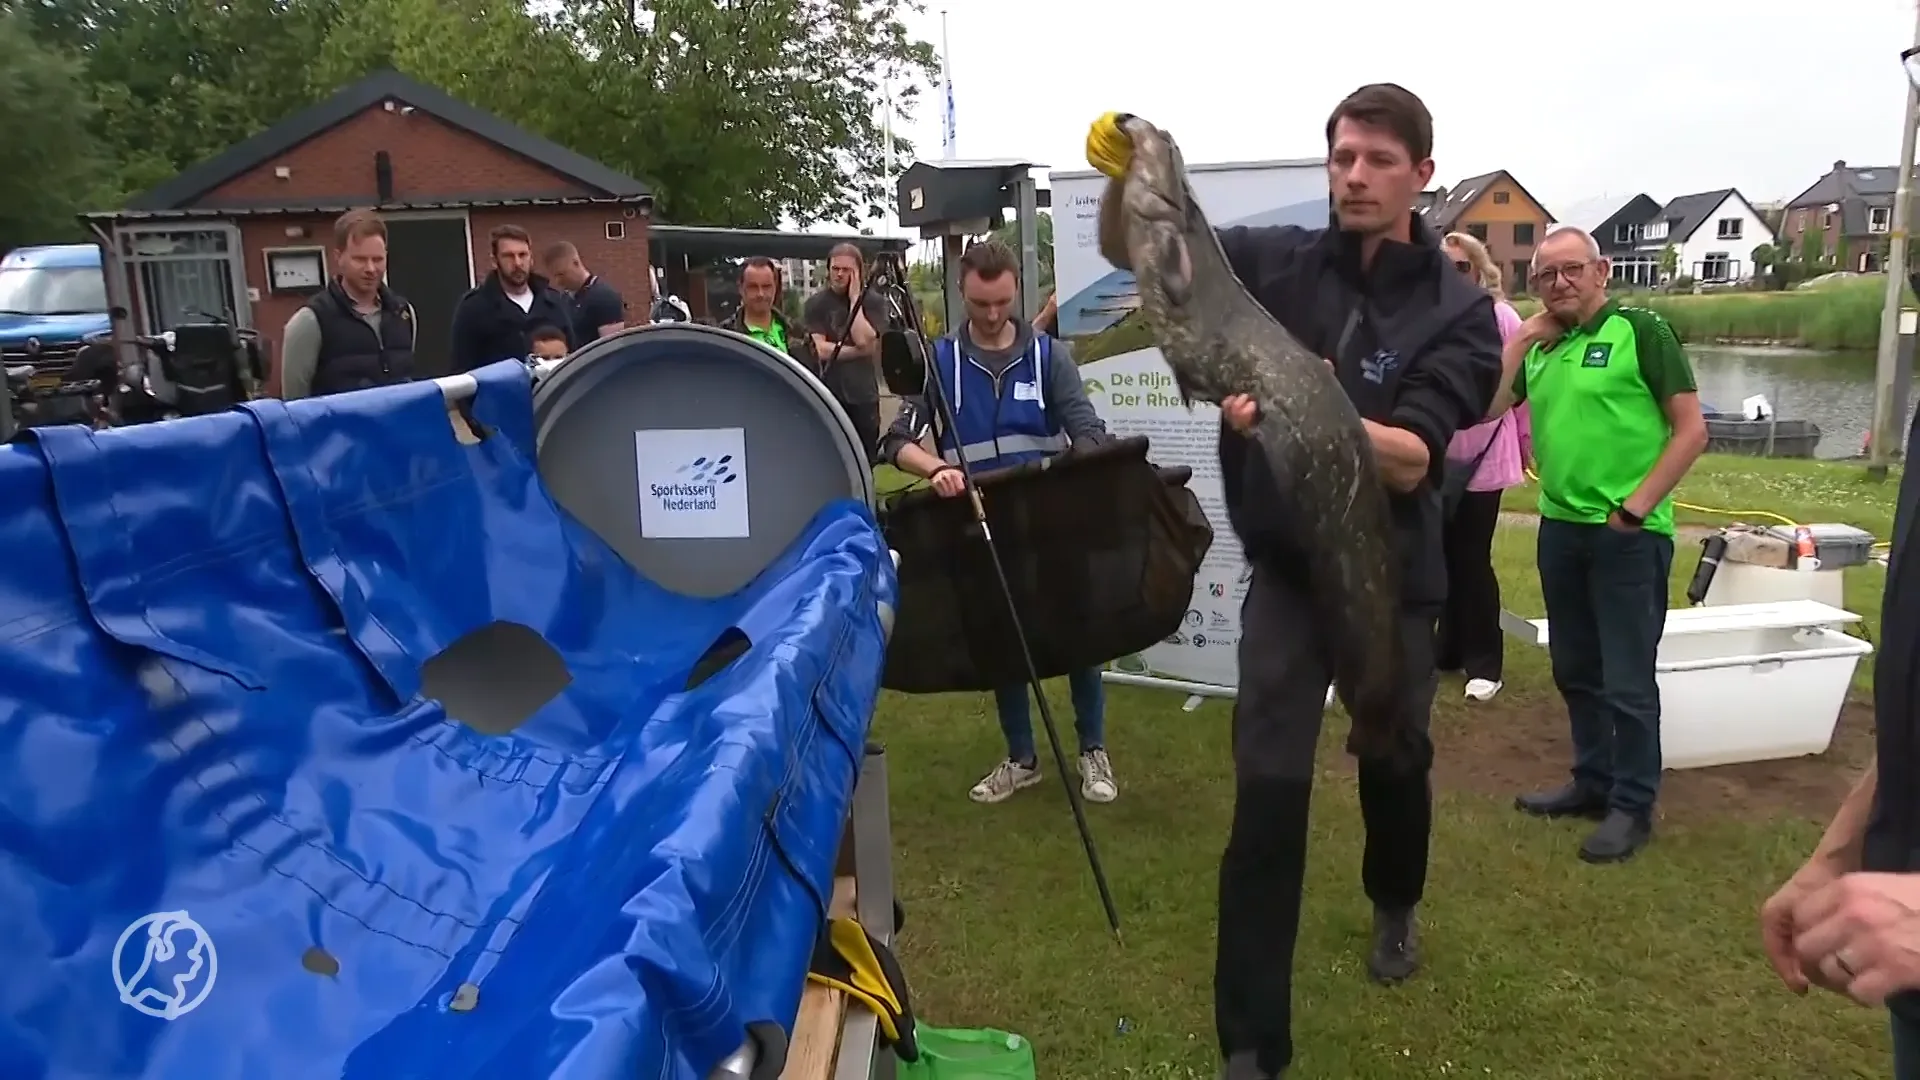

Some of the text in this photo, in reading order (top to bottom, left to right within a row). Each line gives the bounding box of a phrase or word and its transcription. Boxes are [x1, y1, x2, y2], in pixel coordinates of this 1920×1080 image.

[1111, 371, 1171, 389] De Rijn
[1111, 393, 1140, 406] Der
[662, 498, 717, 511] Nederland
